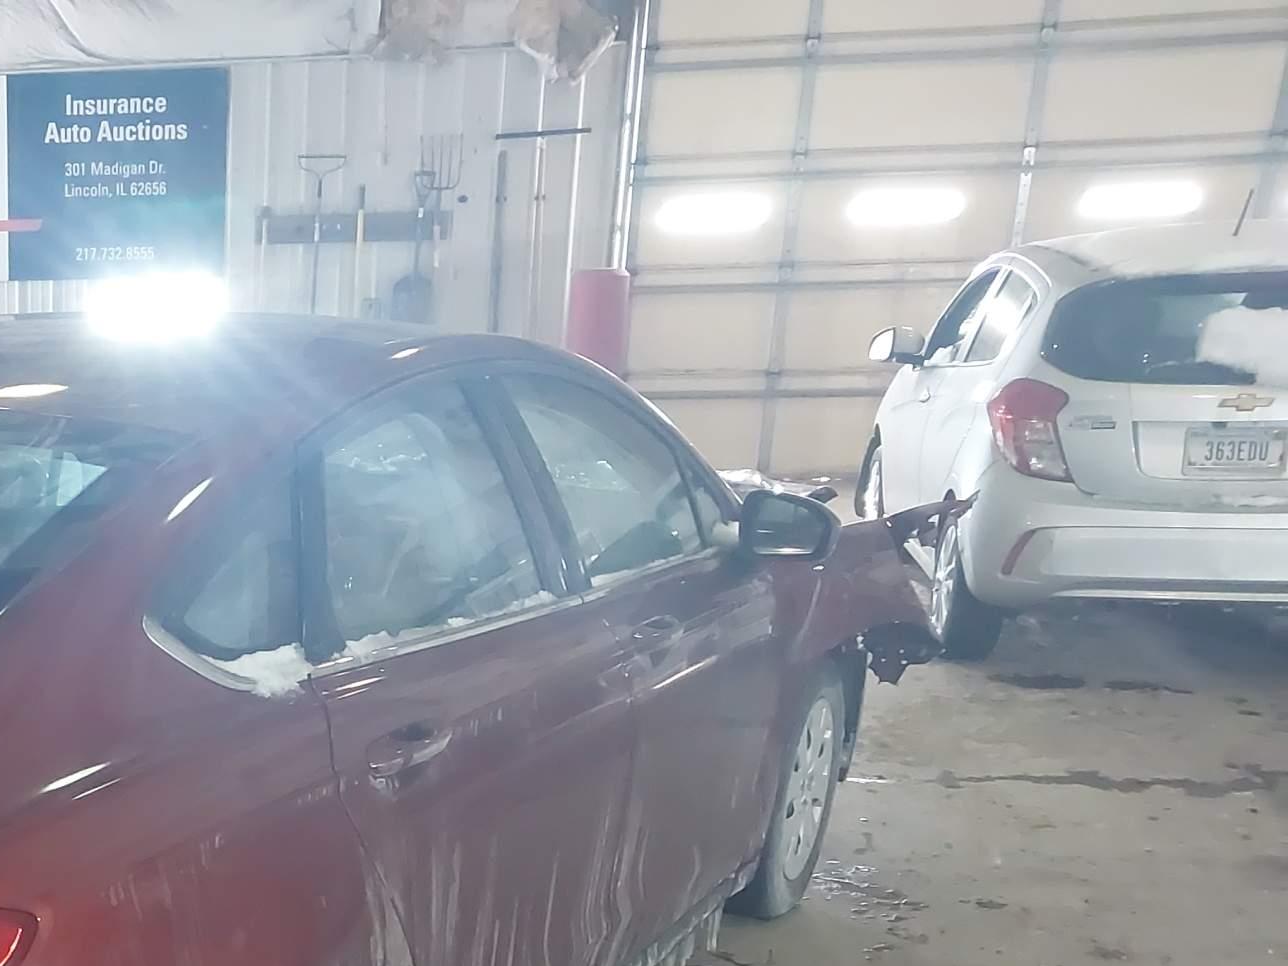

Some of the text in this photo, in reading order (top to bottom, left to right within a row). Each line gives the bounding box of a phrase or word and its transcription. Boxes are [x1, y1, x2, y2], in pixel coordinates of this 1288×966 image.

[65, 94, 167, 115] Insurance
[44, 119, 188, 143] Auto Auctions
[64, 161, 166, 178] 301 Madigan Dr.
[64, 182, 167, 198] Lincoln, IL 62656
[75, 247, 155, 261] 217.732.8555
[1204, 440, 1269, 462] 363EDU
